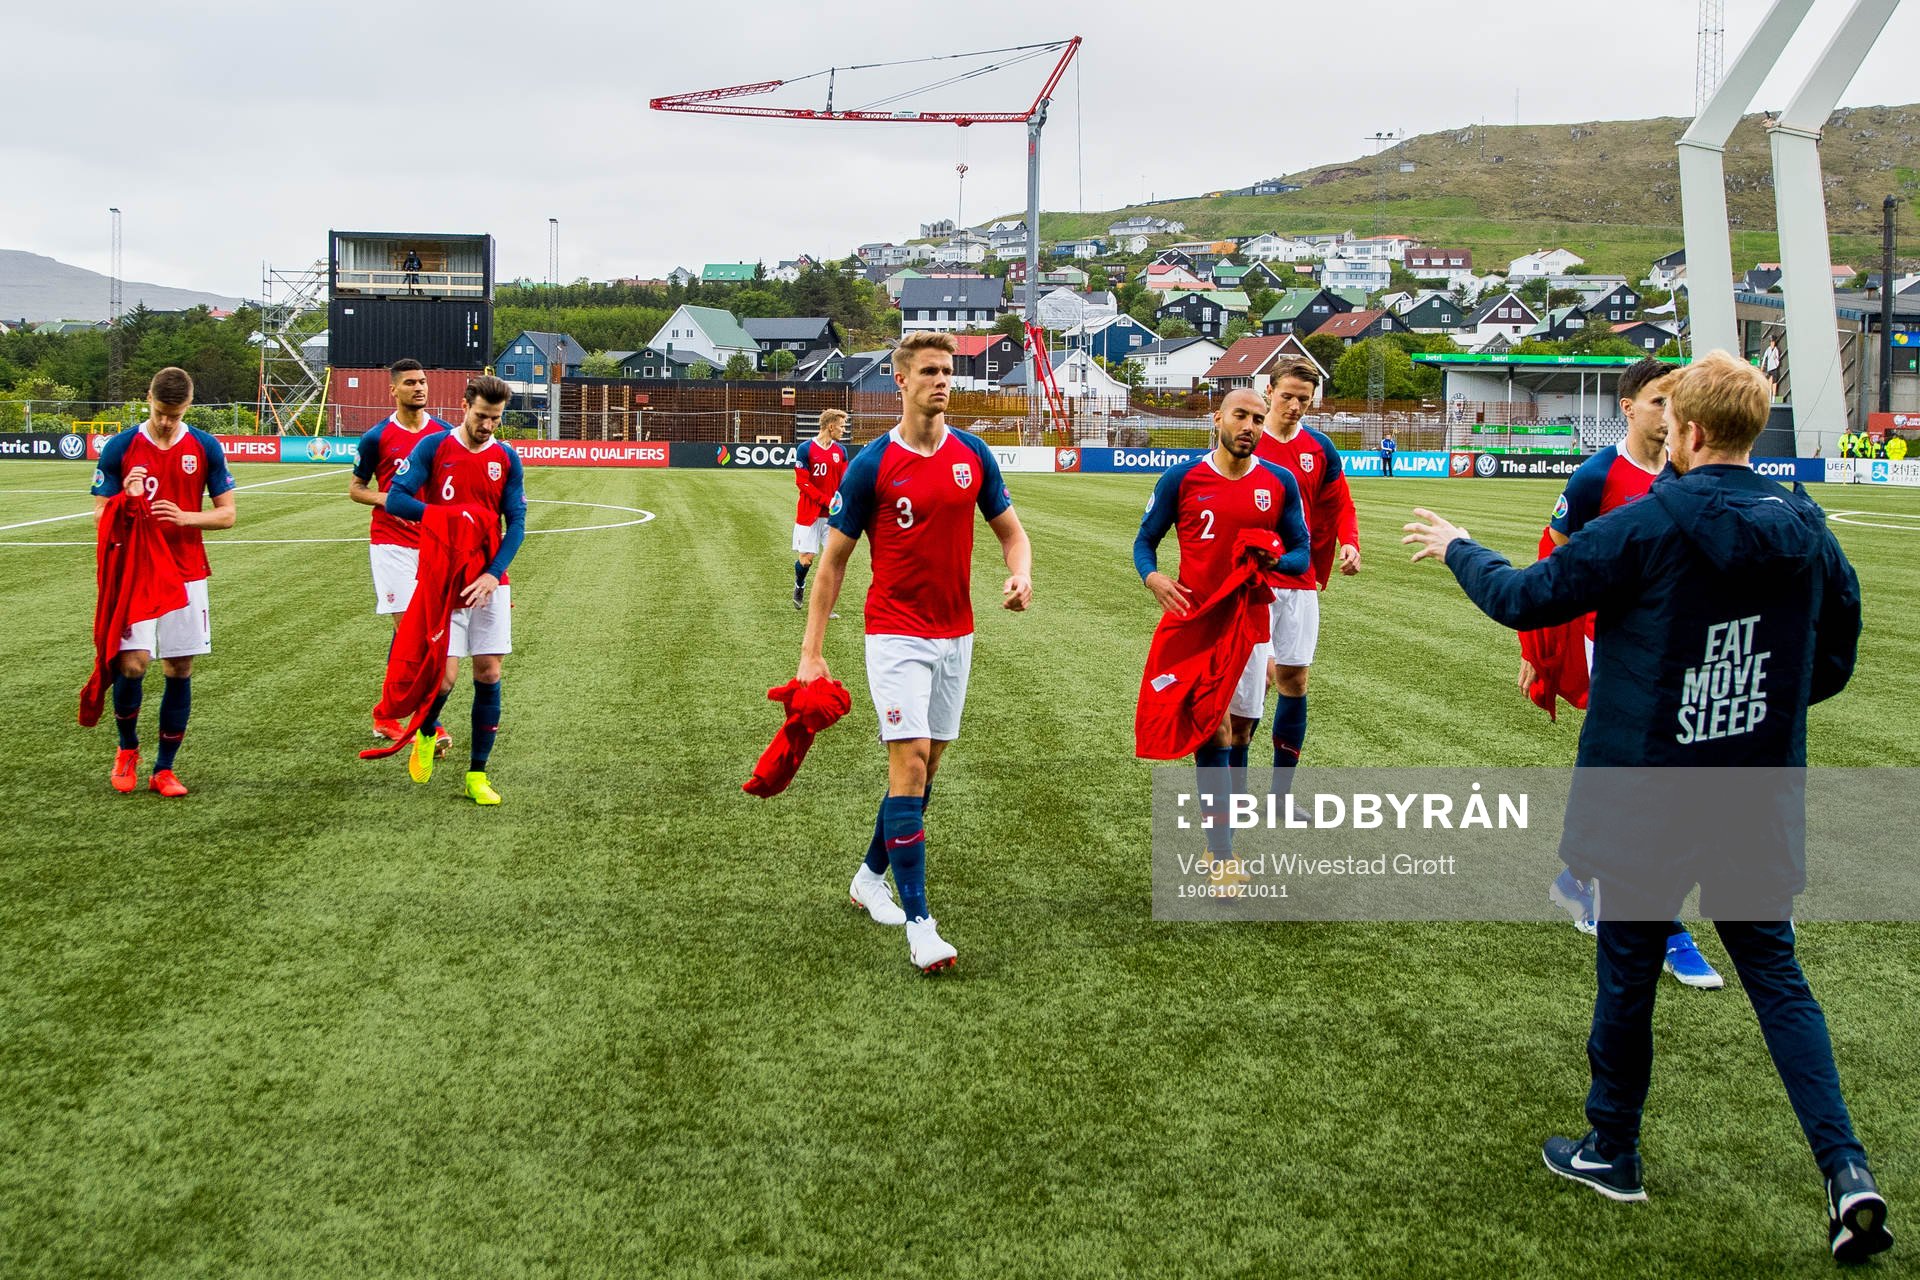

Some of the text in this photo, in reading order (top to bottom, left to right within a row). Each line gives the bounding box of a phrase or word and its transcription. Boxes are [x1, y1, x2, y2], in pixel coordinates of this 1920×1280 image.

[1425, 353, 1441, 361] betri
[0, 440, 55, 454] tric ID.
[516, 446, 665, 461] EUROPEAN QUALIFIERS
[998, 453, 1016, 464] TV
[1394, 457, 1446, 472] ALIPAY
[813, 463, 827, 476] 20
[1501, 460, 1526, 473] The
[1827, 463, 1852, 471] UEFA
[442, 475, 455, 501] 6
[896, 497, 914, 529] 3
[1200, 509, 1215, 540] 2
[1704, 615, 1761, 665] EAT
[1682, 651, 1771, 710] MOVE
